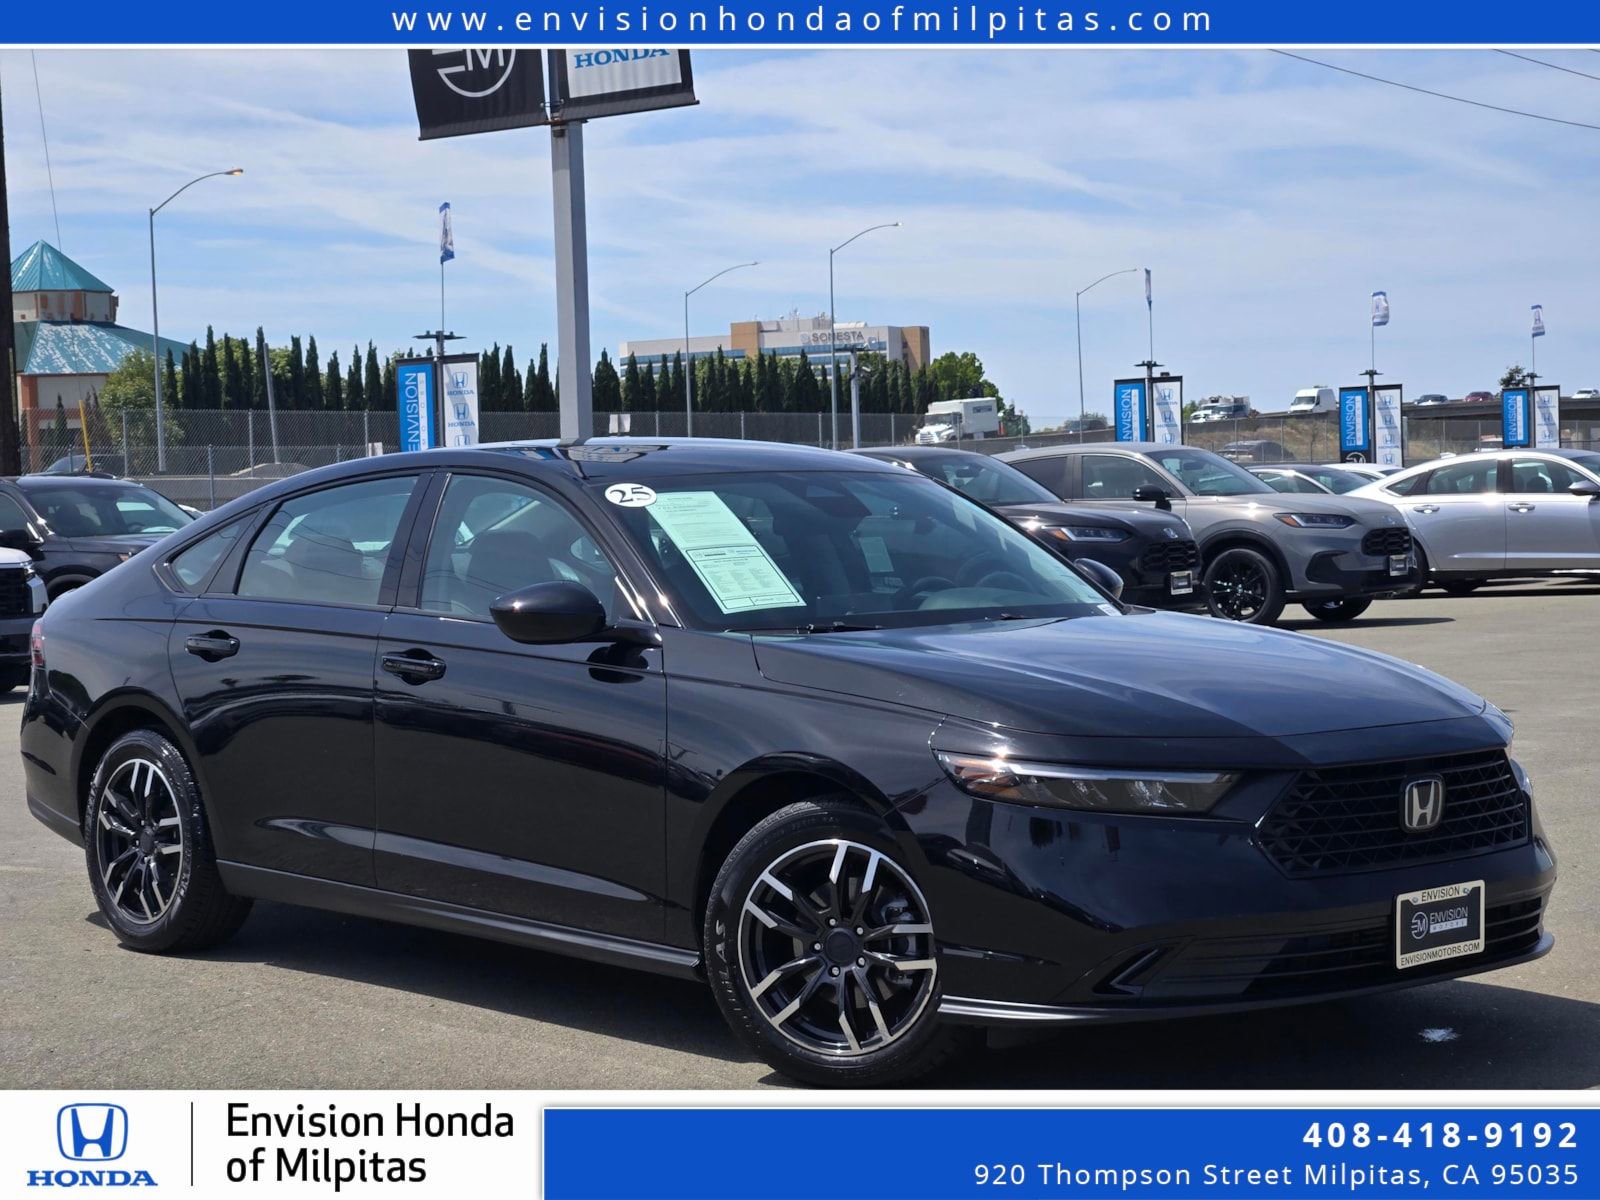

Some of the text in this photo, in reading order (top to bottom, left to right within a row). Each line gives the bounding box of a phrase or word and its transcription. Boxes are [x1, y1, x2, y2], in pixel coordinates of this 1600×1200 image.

[405, 372, 420, 452] ENVISION
[1345, 395, 1356, 447] ENVISION
[1507, 395, 1518, 441] ENVISION
[609, 486, 652, 504] 25
[1421, 885, 1460, 902] ENVISION
[1430, 906, 1469, 924] ENVISION
[1400, 942, 1480, 966] ENVISIONMOTORS.COM
